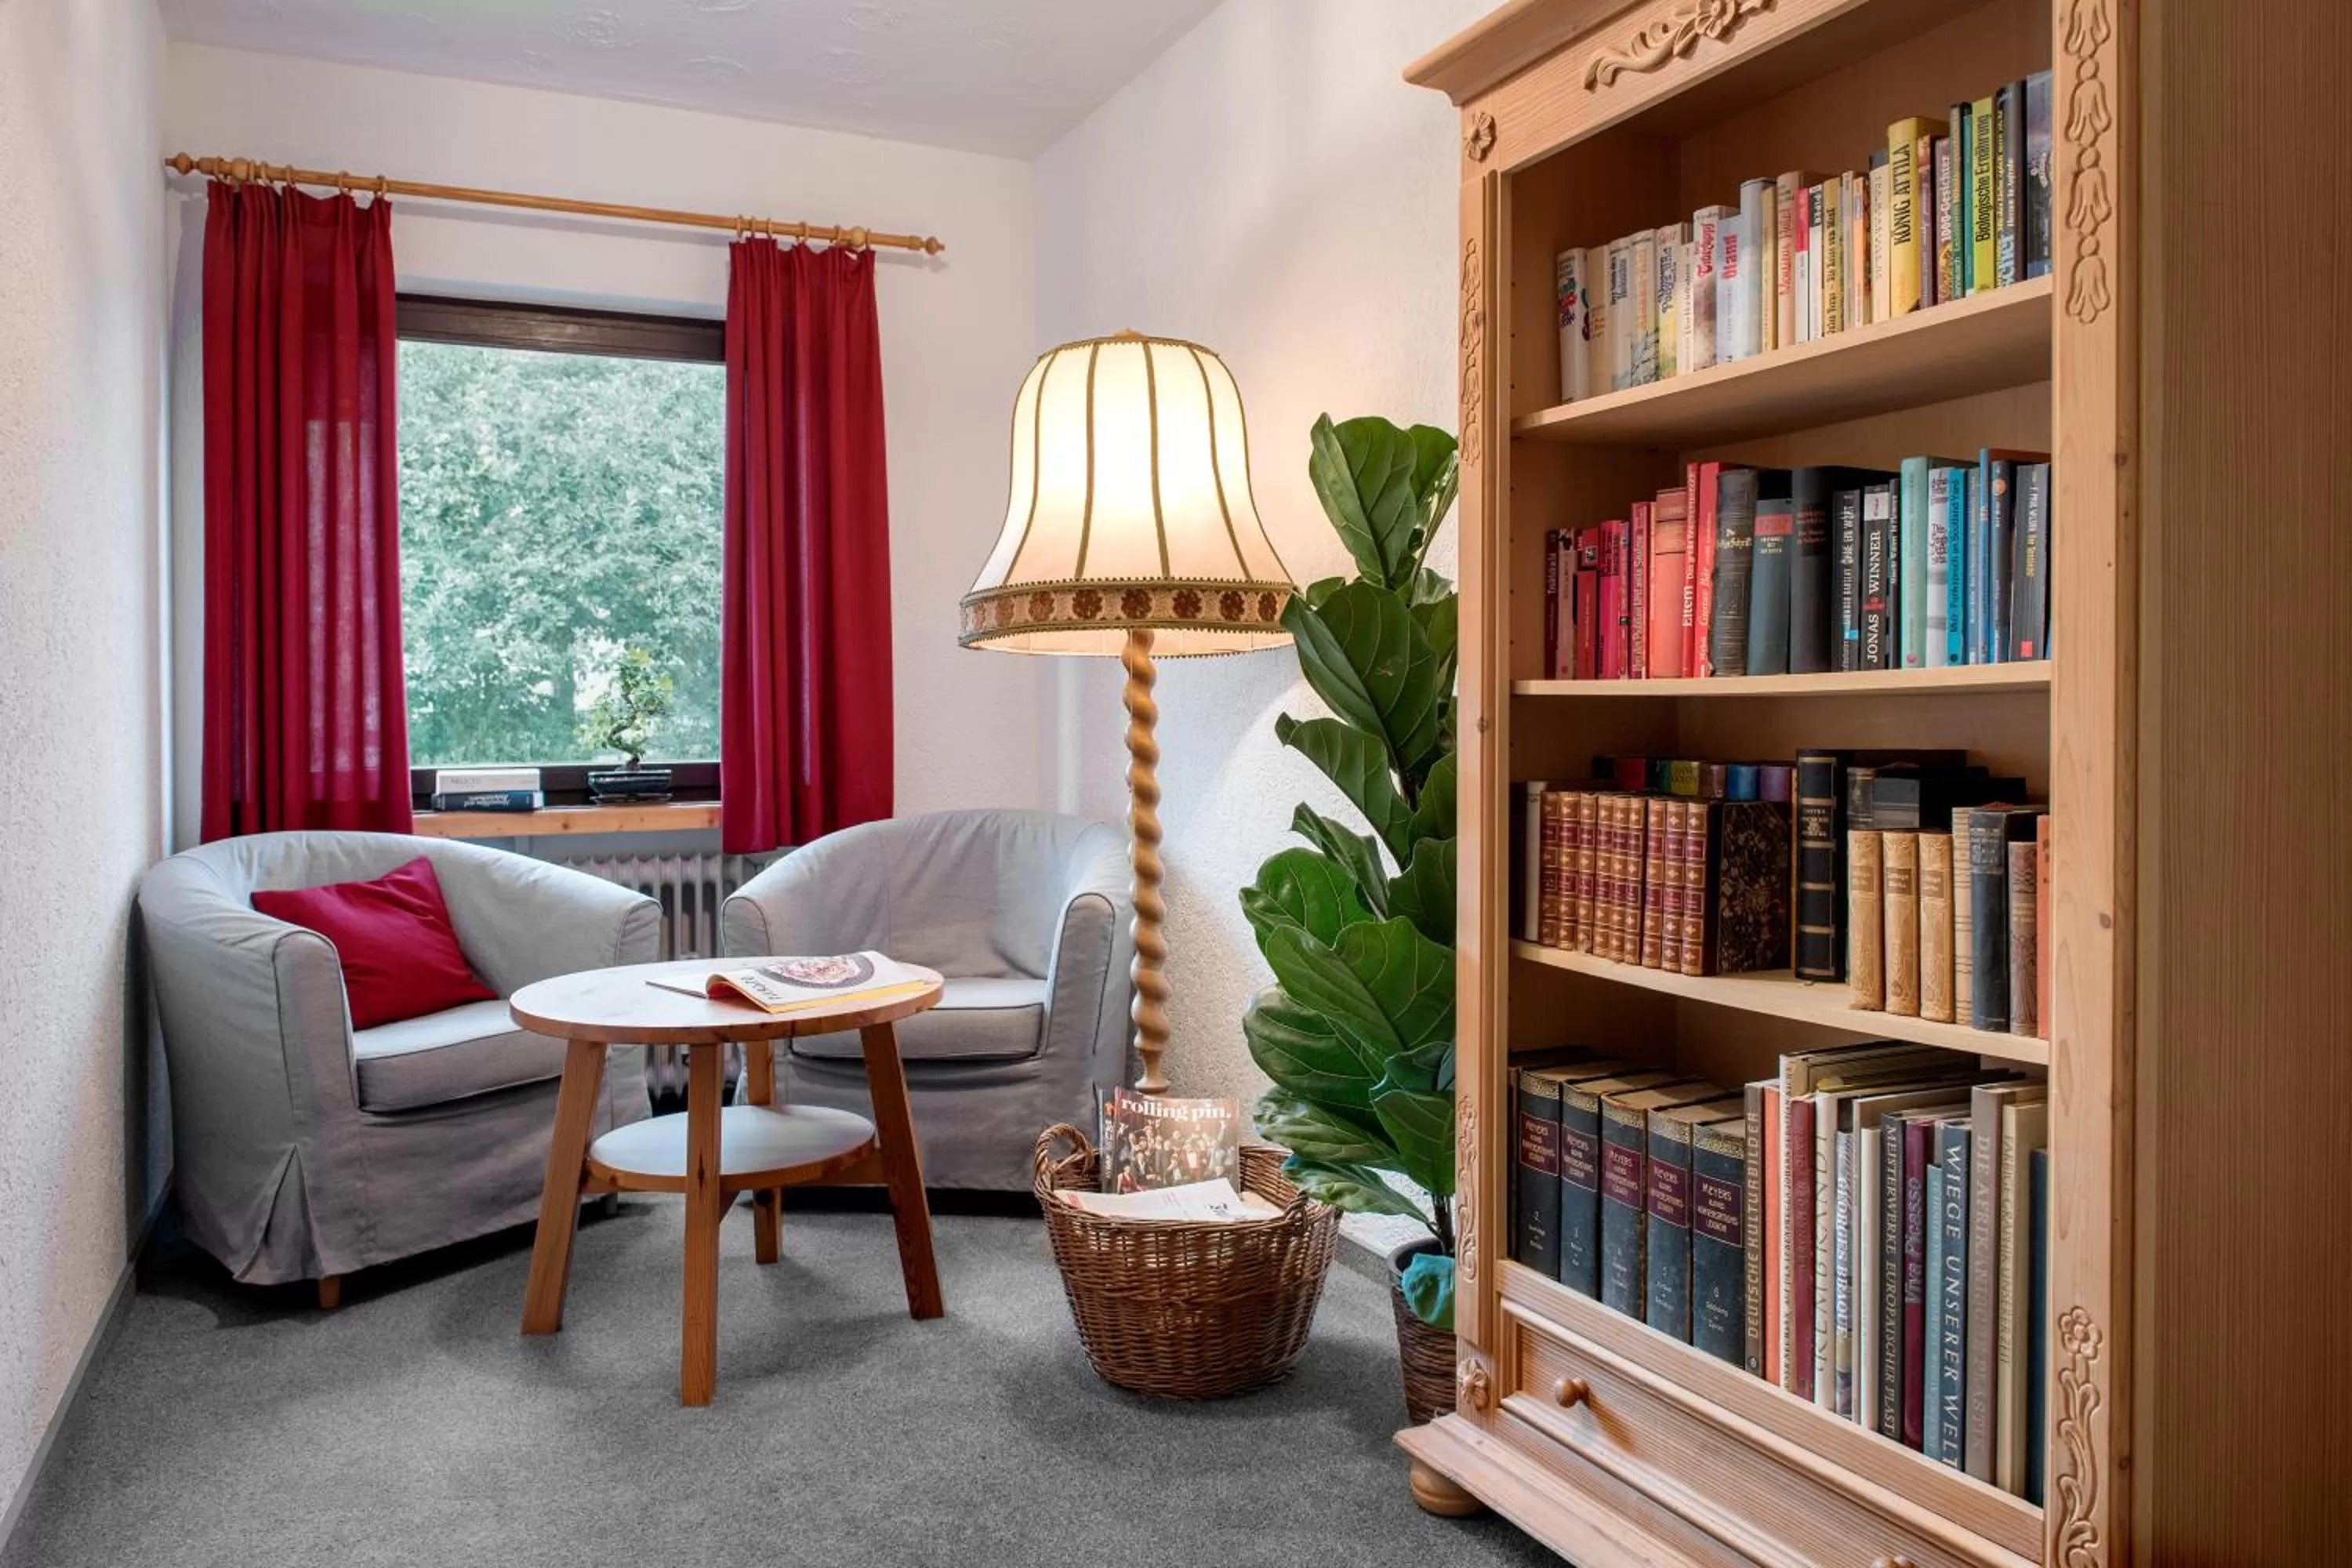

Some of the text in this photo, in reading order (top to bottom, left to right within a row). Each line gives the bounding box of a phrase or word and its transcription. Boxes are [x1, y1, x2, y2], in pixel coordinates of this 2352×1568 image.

[1890, 143, 1911, 245] KÖNIG ATTILA
[1975, 113, 1992, 241] Biologische Ernährung
[1682, 585, 1693, 626] Eltern
[1867, 530, 1881, 662] JONAS WINNER
[1121, 1098, 1189, 1119] rolling
[1976, 1134, 1990, 1176] DIE
[1746, 1111, 1759, 1338] DEUTSCHE KULTURBILDER
[1885, 1126, 1896, 1254] MEISTERWERKE
[1905, 1177, 1923, 1305] Viva Picasso
[1835, 1177, 1848, 1336] GEORGES BRAQUE
[1941, 1145, 1962, 1468] WIEGE UNSERER WELT
[1883, 1386, 1895, 1438] PLASTI
